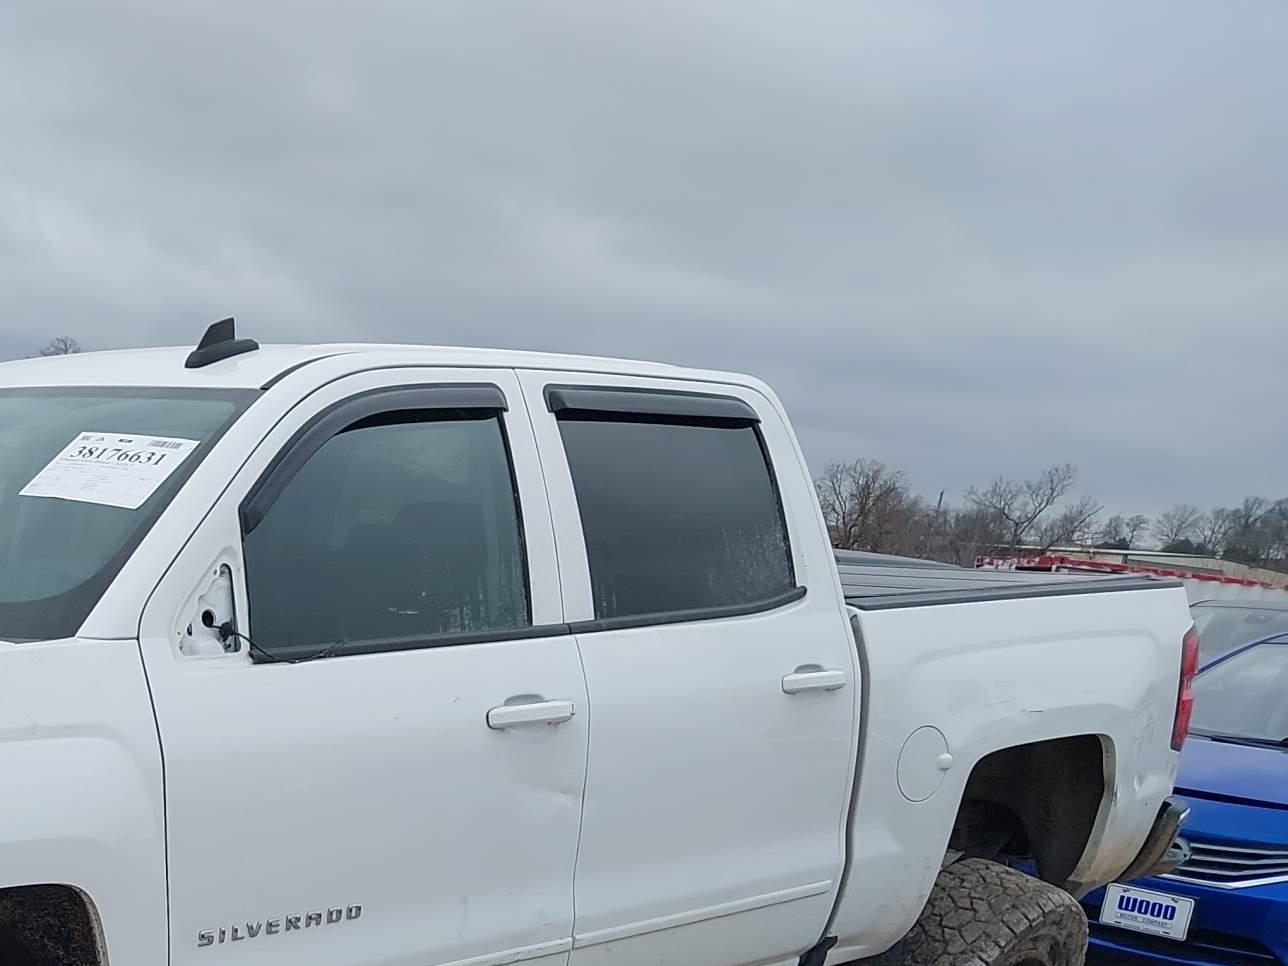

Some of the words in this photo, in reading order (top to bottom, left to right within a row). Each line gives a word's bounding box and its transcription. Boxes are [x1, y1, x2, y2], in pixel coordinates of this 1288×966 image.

[69, 445, 168, 466] 38176631
[1117, 894, 1177, 921] WOOD
[197, 903, 362, 947] SILVERADO
